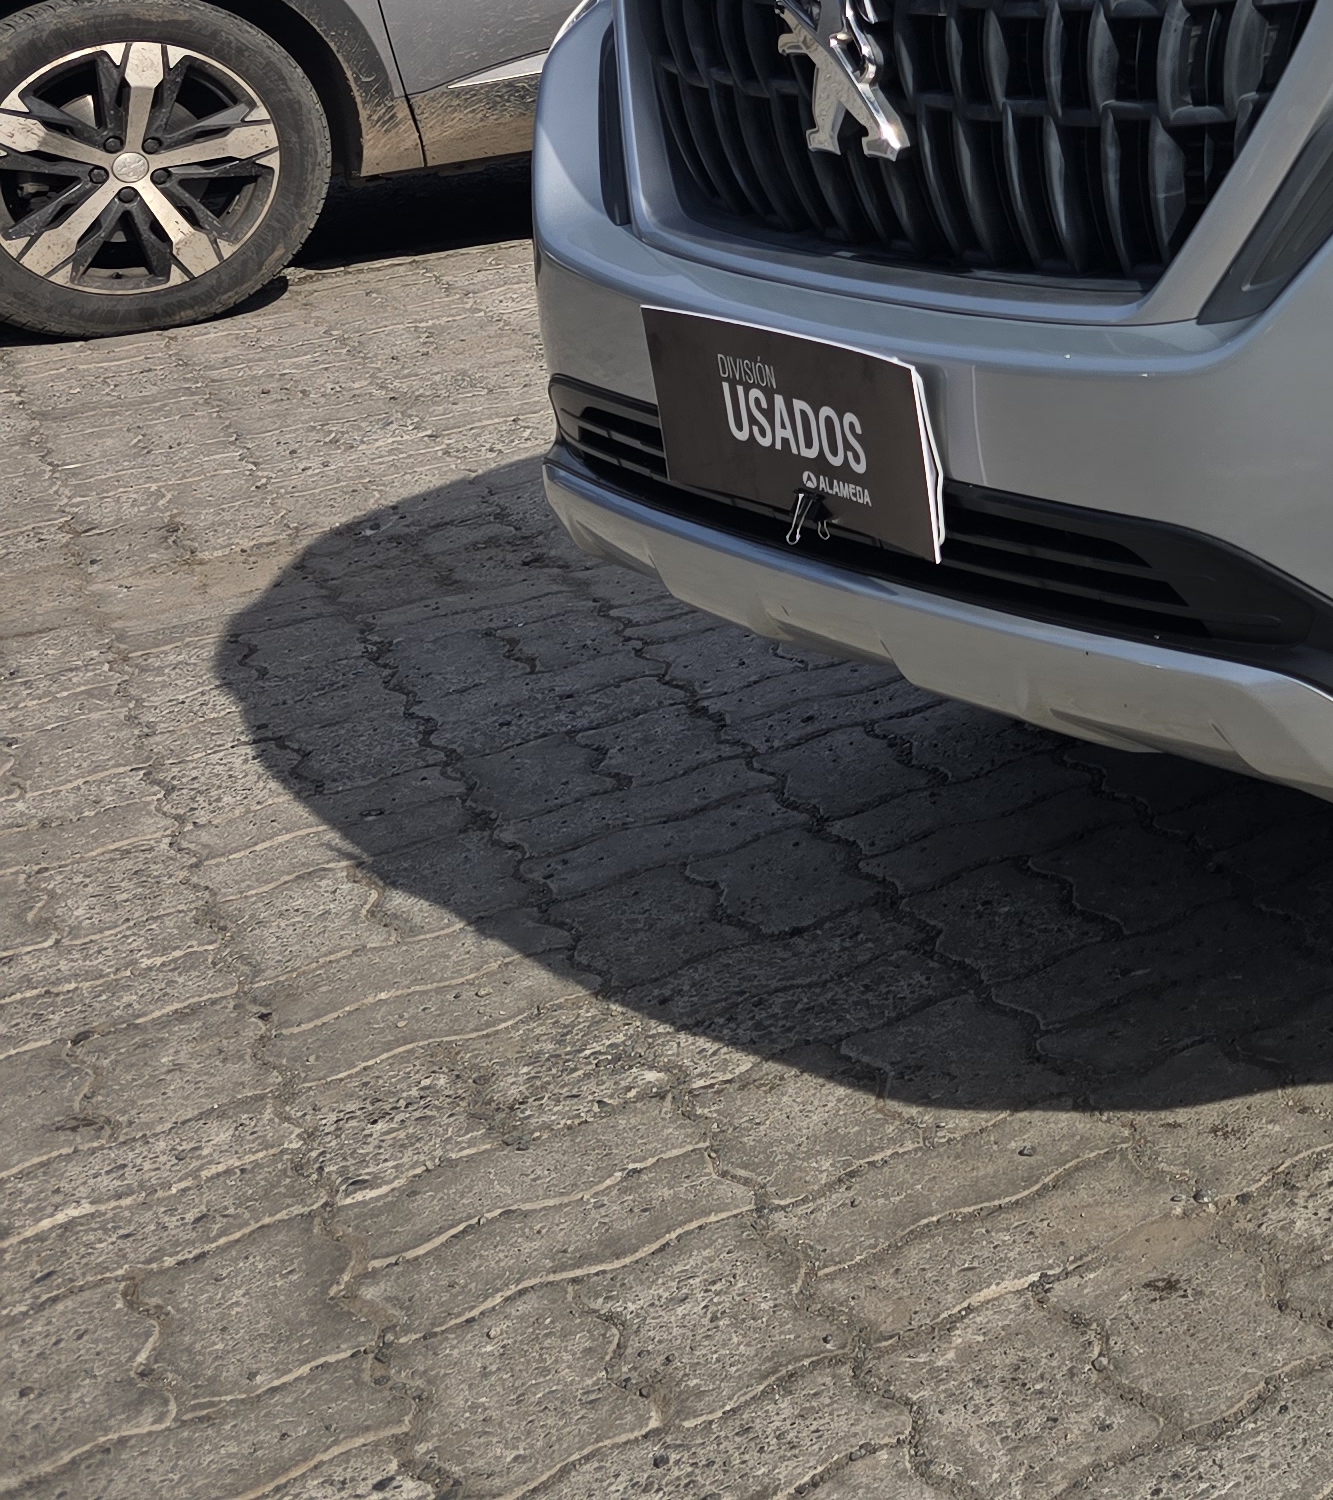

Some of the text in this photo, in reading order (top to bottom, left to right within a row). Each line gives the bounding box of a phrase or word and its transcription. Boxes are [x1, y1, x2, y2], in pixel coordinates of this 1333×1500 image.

[717, 353, 777, 389] DIVISIÓN
[721, 381, 867, 474] USADOS
[819, 475, 873, 507] ALAMEDA
